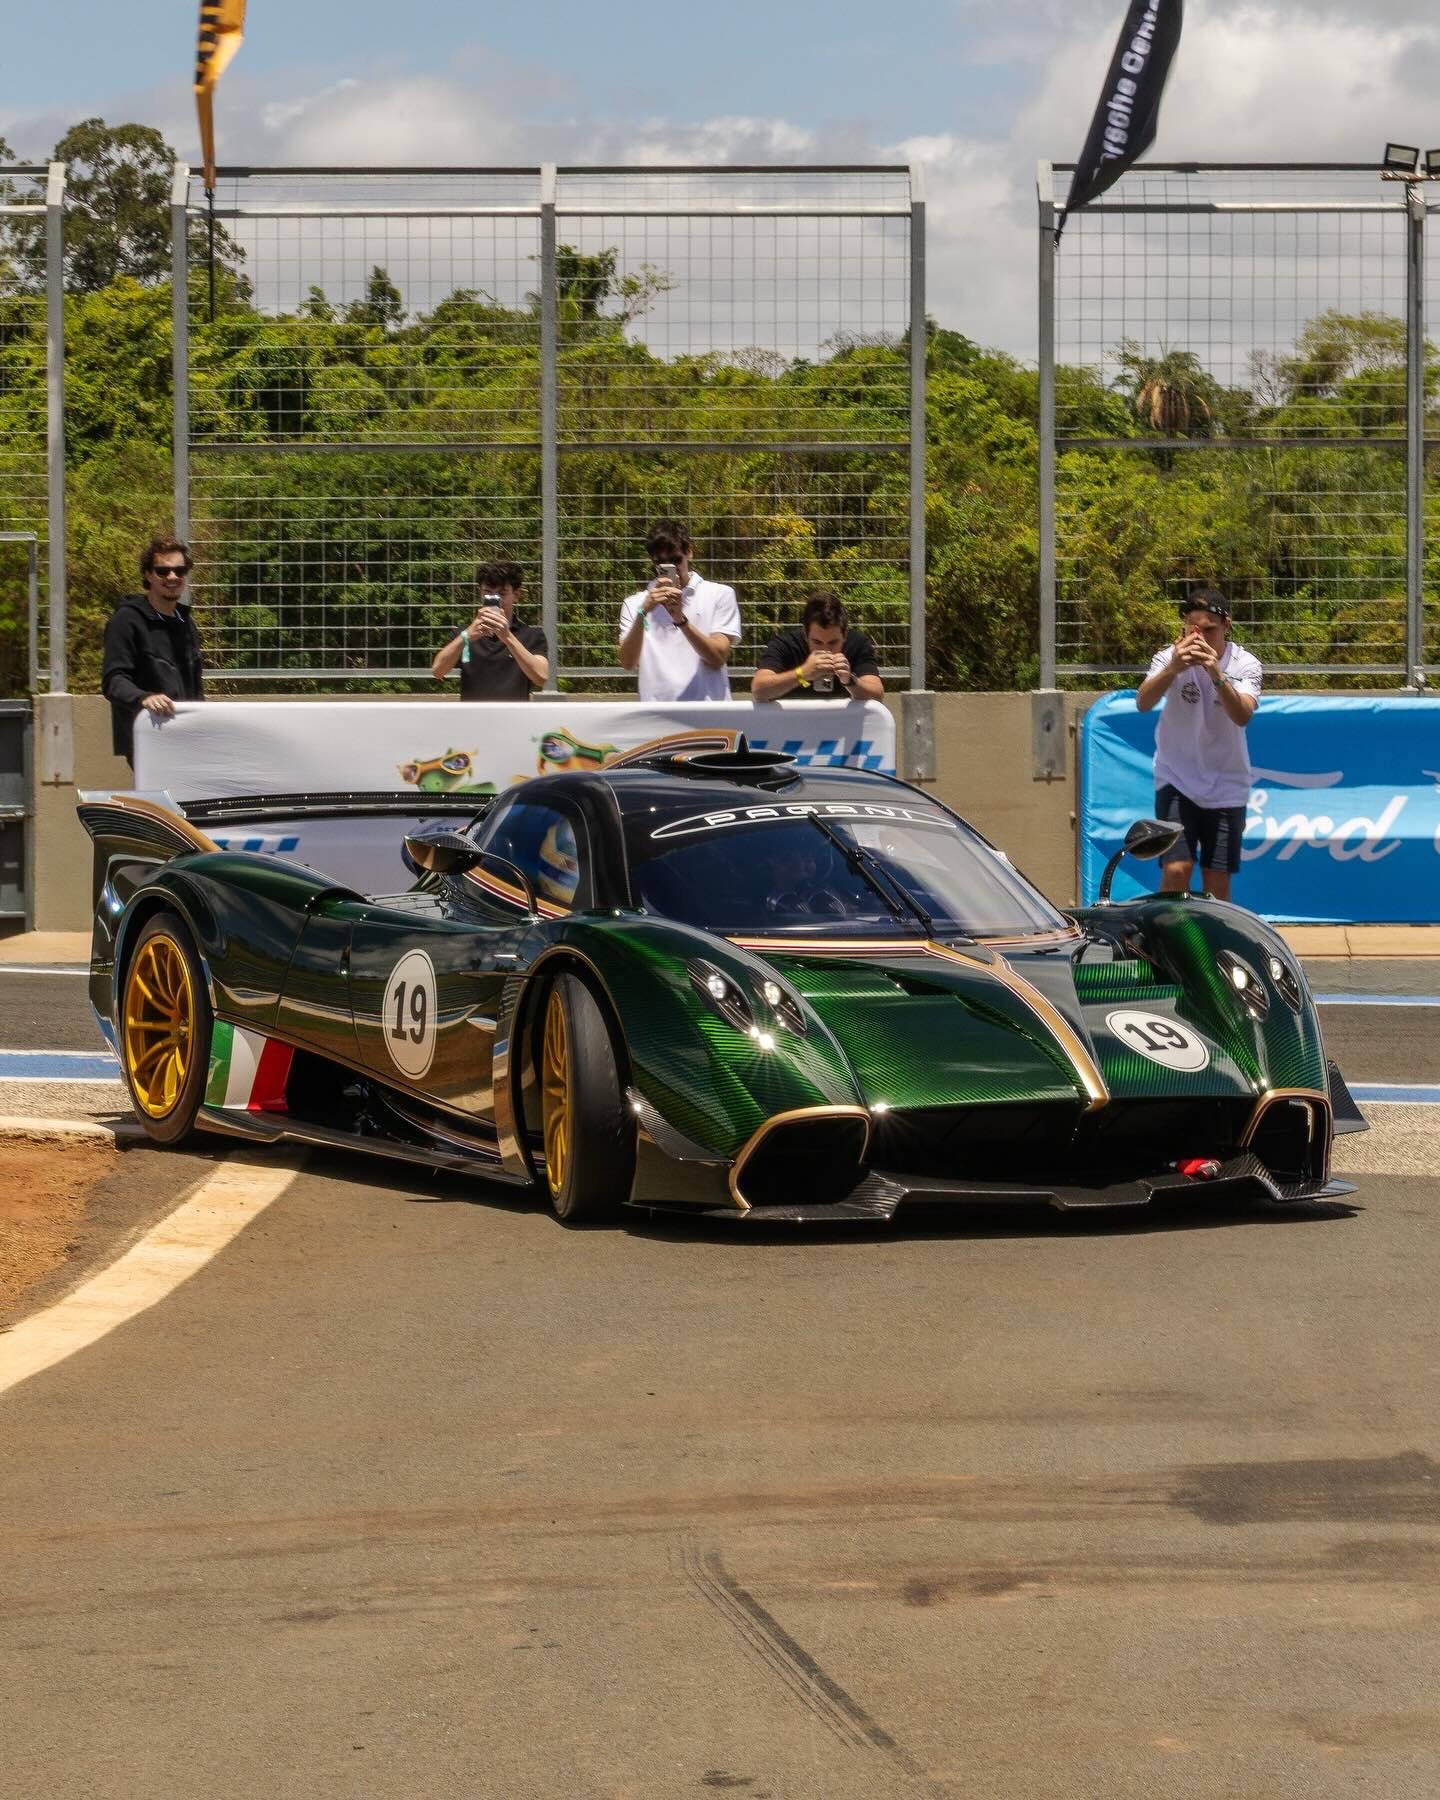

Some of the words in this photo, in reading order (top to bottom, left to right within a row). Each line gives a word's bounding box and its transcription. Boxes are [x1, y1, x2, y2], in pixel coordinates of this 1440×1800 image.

[704, 805, 913, 826] PAGANI
[391, 980, 427, 1045] 19
[1124, 1021, 1189, 1051] 19
